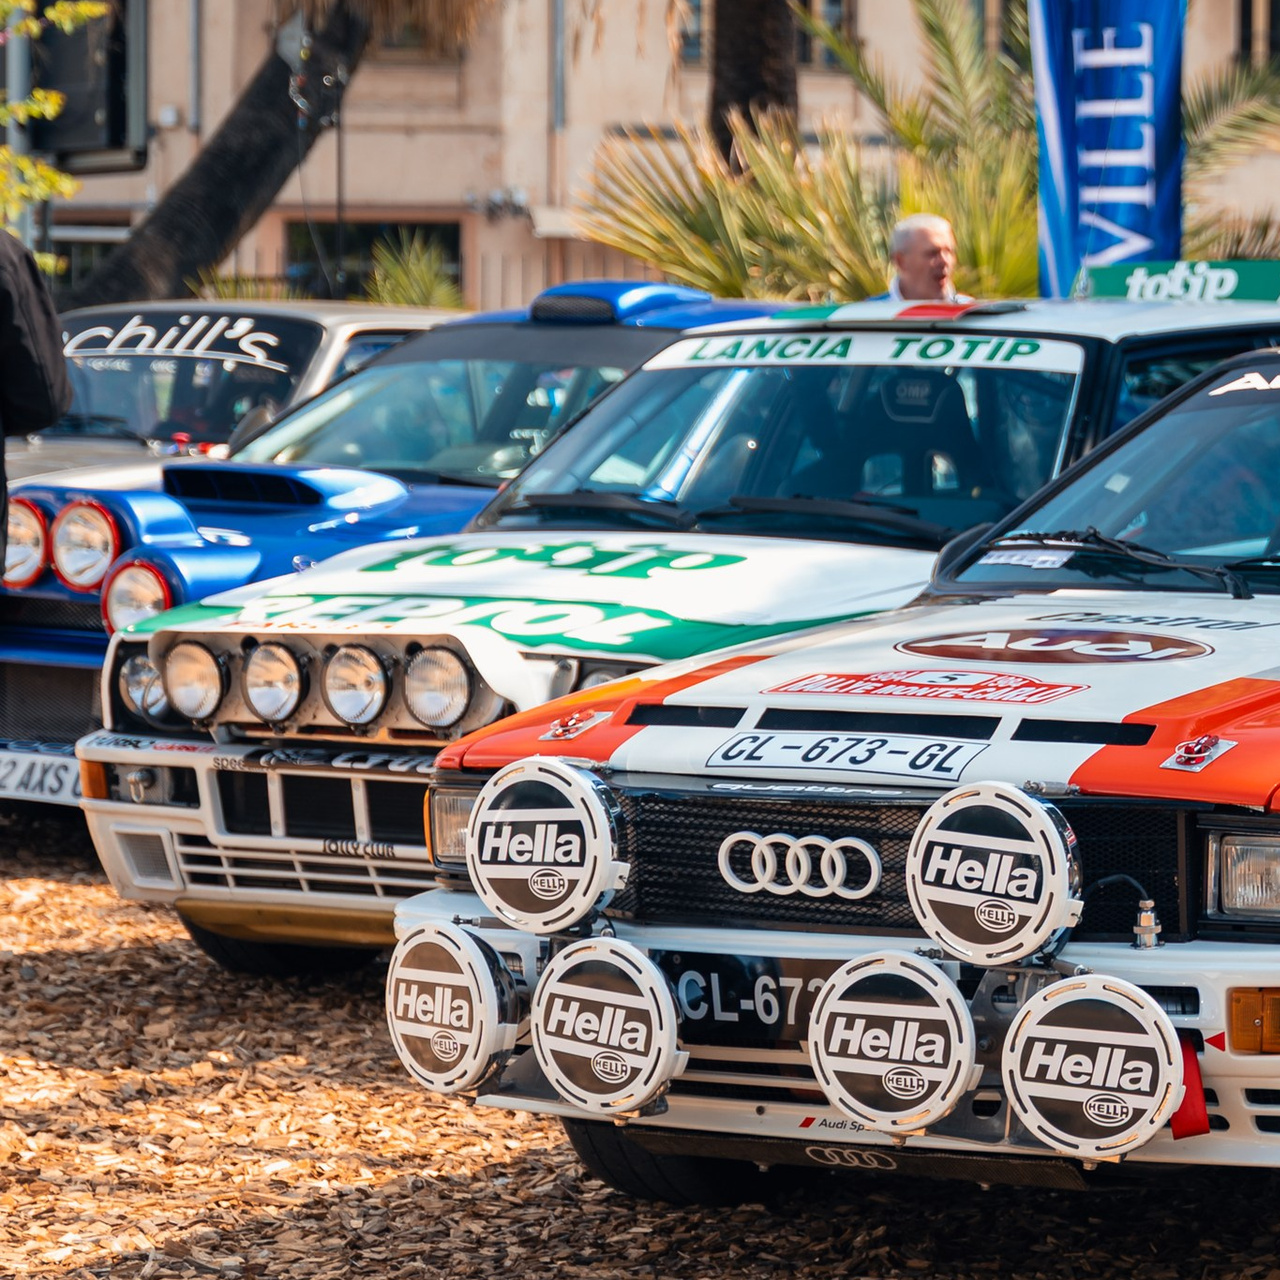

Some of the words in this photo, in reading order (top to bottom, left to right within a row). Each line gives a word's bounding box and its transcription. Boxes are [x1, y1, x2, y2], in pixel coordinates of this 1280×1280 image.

[1072, 20, 1156, 267] VILLE
[1126, 261, 1239, 302] totip
[62, 314, 281, 364] chill's
[688, 337, 853, 361] LANCIA
[889, 337, 1042, 362] TOTIP
[927, 673, 970, 684] 5
[481, 823, 582, 864] Hella
[531, 876, 566, 891] HELLA
[924, 845, 1039, 900] Hella
[978, 907, 1016, 926] HELLA
[395, 982, 470, 1029] Hella
[546, 997, 649, 1054] Hella
[827, 1016, 946, 1064] Hella
[433, 1038, 459, 1053] HELLA
[593, 1056, 630, 1077] HELLA
[886, 1075, 926, 1091] HELLA
[1024, 1042, 1153, 1093] Hella
[819, 1118, 848, 1130] Audi
[1087, 1100, 1131, 1118] HELLA
